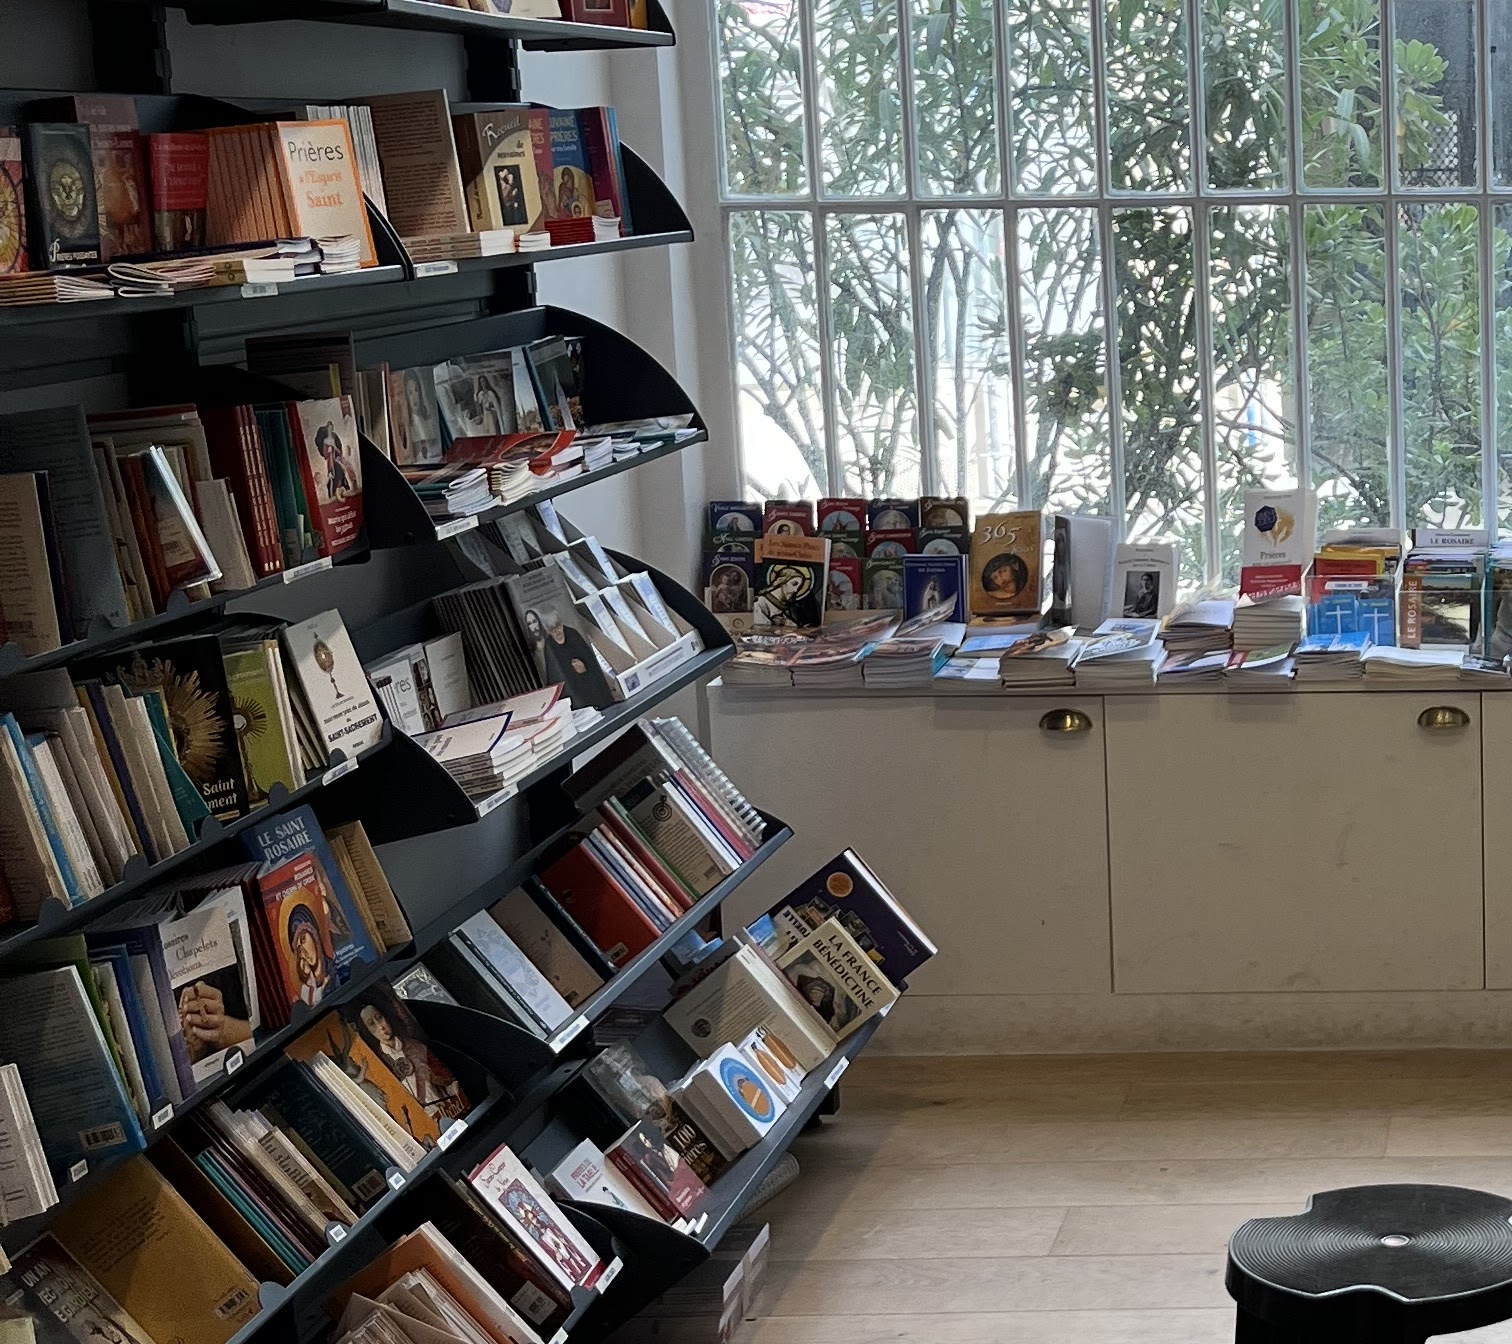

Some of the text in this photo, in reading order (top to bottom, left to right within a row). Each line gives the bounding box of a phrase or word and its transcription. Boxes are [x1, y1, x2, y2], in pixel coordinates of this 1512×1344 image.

[288, 140, 344, 162] Prières
[307, 191, 343, 207] Saint
[980, 521, 1022, 546] 365
[1442, 537, 1474, 545] ROSAIRE
[1260, 551, 1286, 560] Prières
[1408, 580, 1418, 638] LE ROSAIRE
[203, 778, 235, 796] Saint
[206, 793, 237, 809] ment
[258, 817, 306, 847] LE SAINT
[264, 831, 313, 862] ROSAIRE
[163, 933, 189, 950] osaires
[175, 937, 219, 962] Chapelets
[813, 939, 875, 1010] BÉNÉDICTINE
[828, 934, 883, 997] LA FRANCE
[673, 1123, 696, 1147] 100
